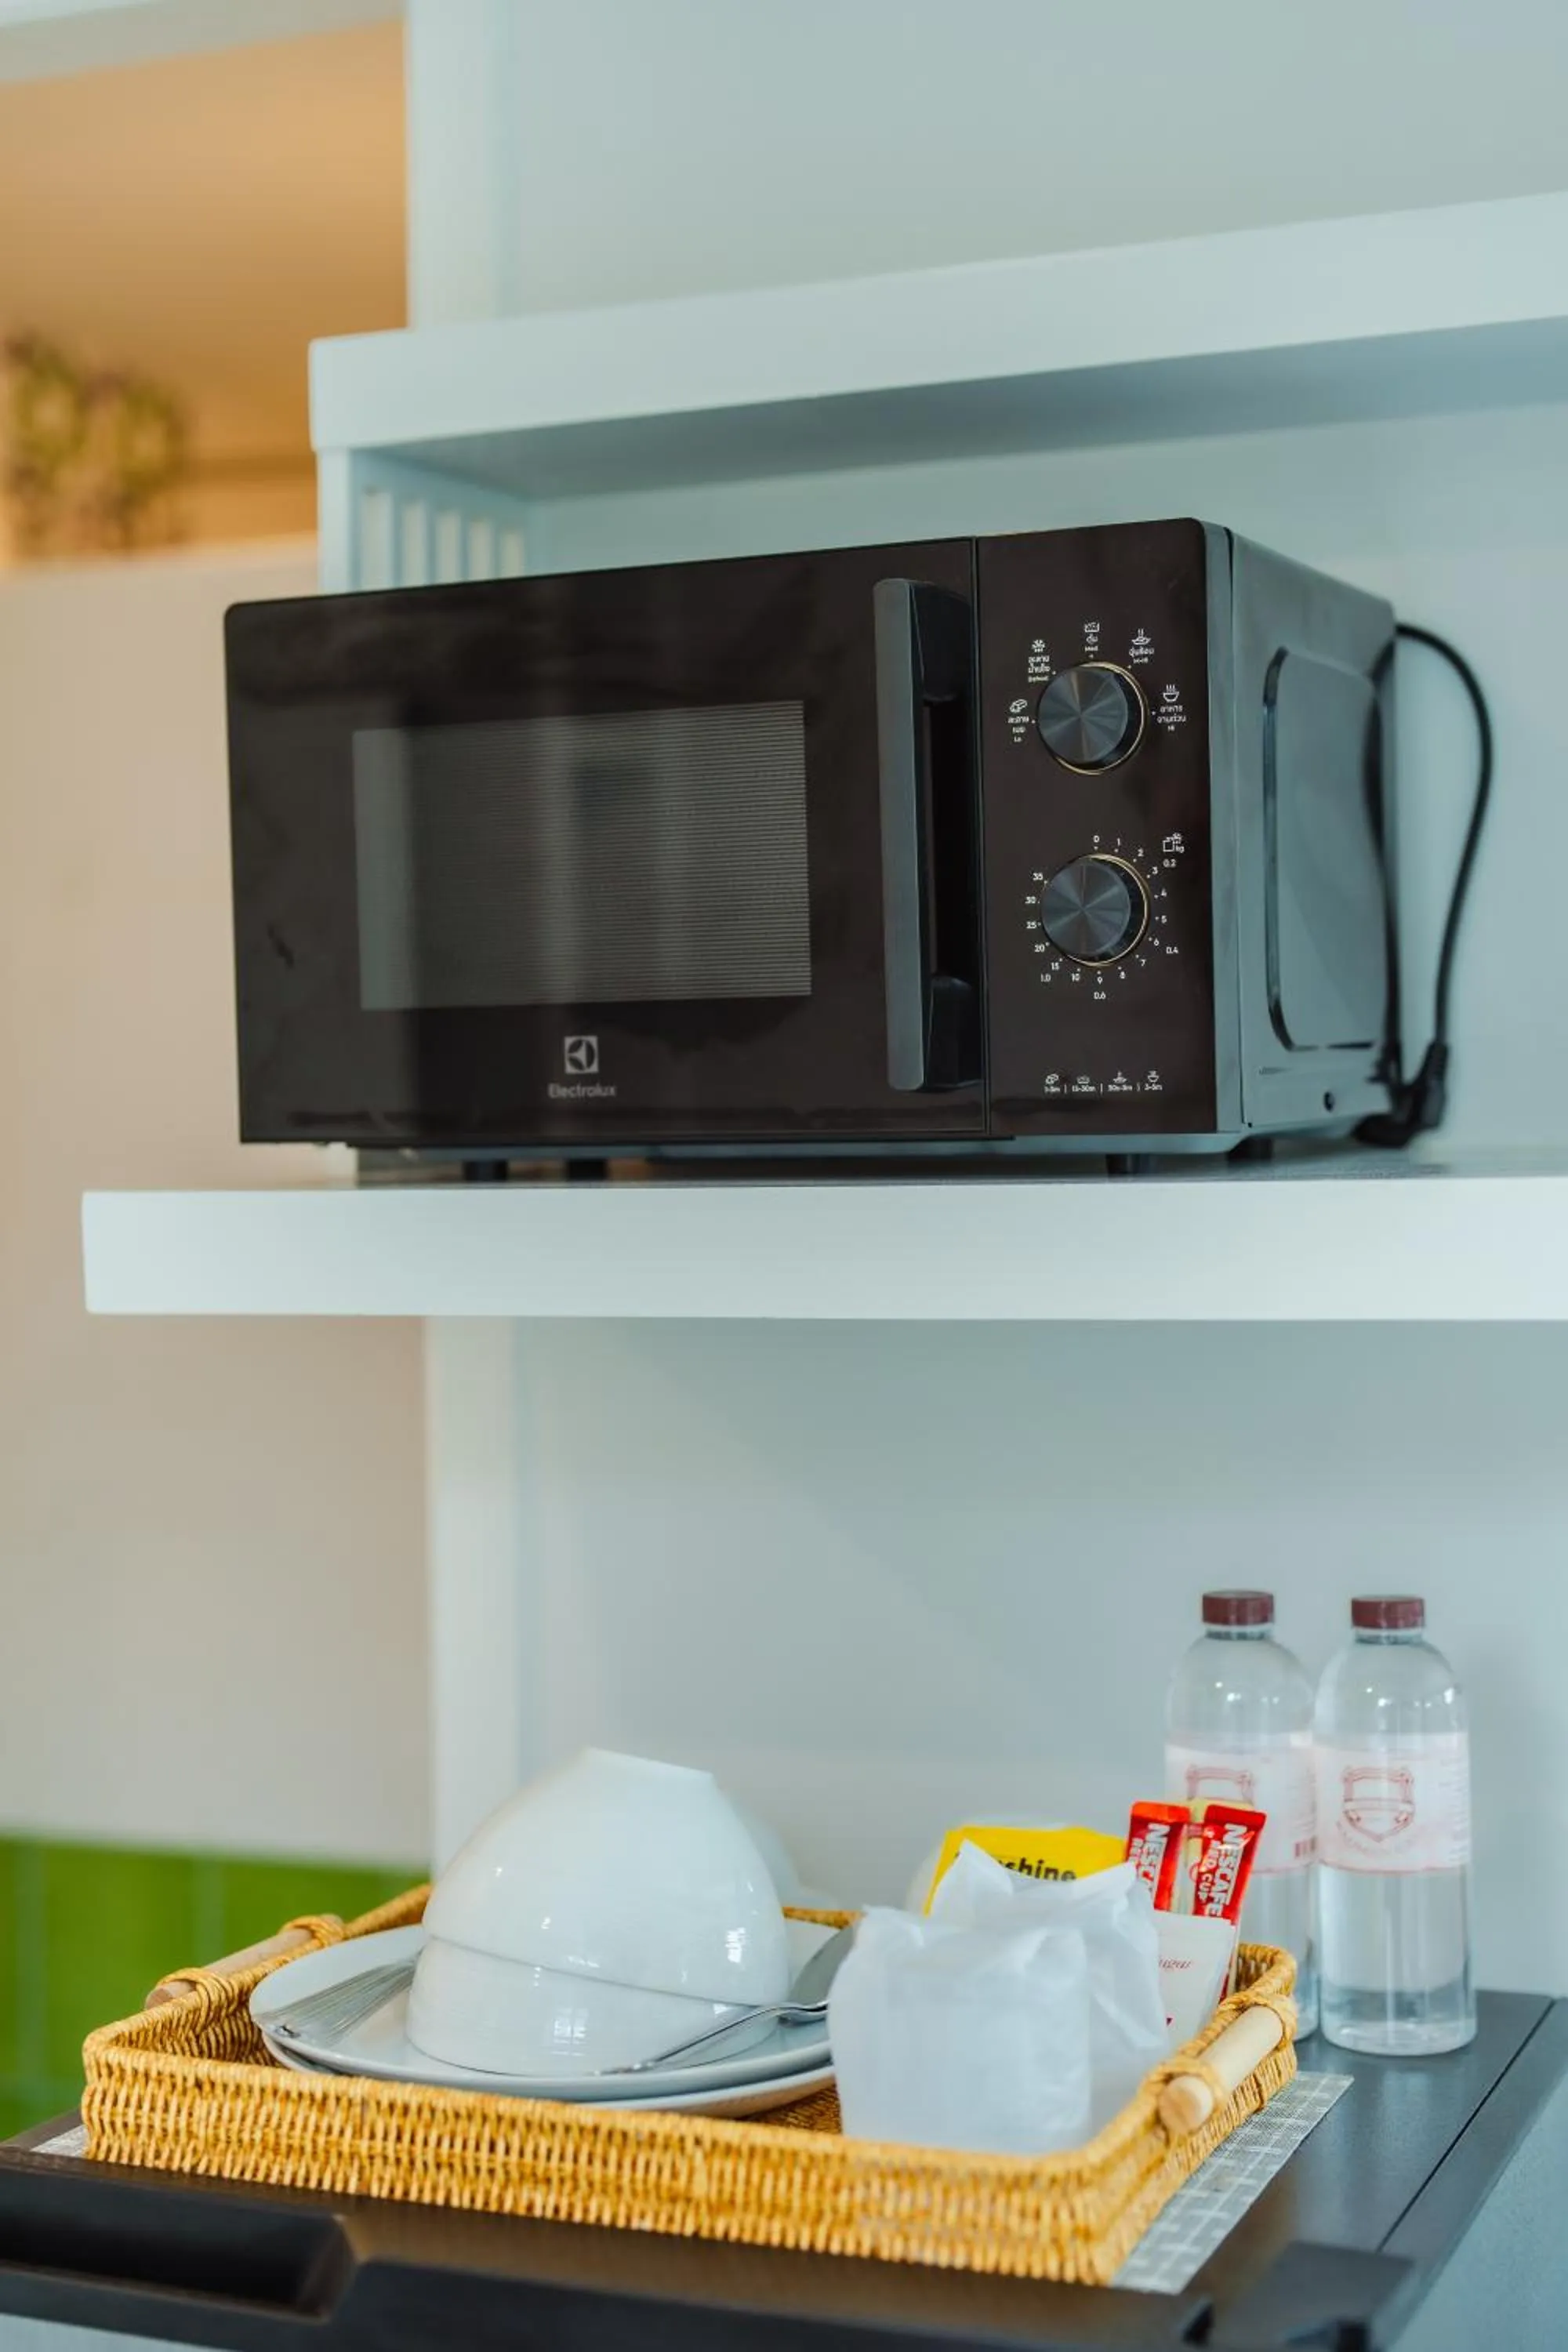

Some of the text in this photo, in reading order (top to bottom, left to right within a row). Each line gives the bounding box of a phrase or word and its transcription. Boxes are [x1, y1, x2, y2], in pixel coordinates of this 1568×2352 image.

[1138, 848, 1145, 857] 2
[1152, 866, 1159, 875] 3
[1033, 873, 1044, 881] 35
[1160, 888, 1167, 897] 4
[1161, 915, 1167, 924] 5
[1153, 938, 1160, 947] 6
[1034, 944, 1045, 953] 20
[1051, 962, 1059, 971] 15
[549, 1083, 616, 1098] Electrolux
